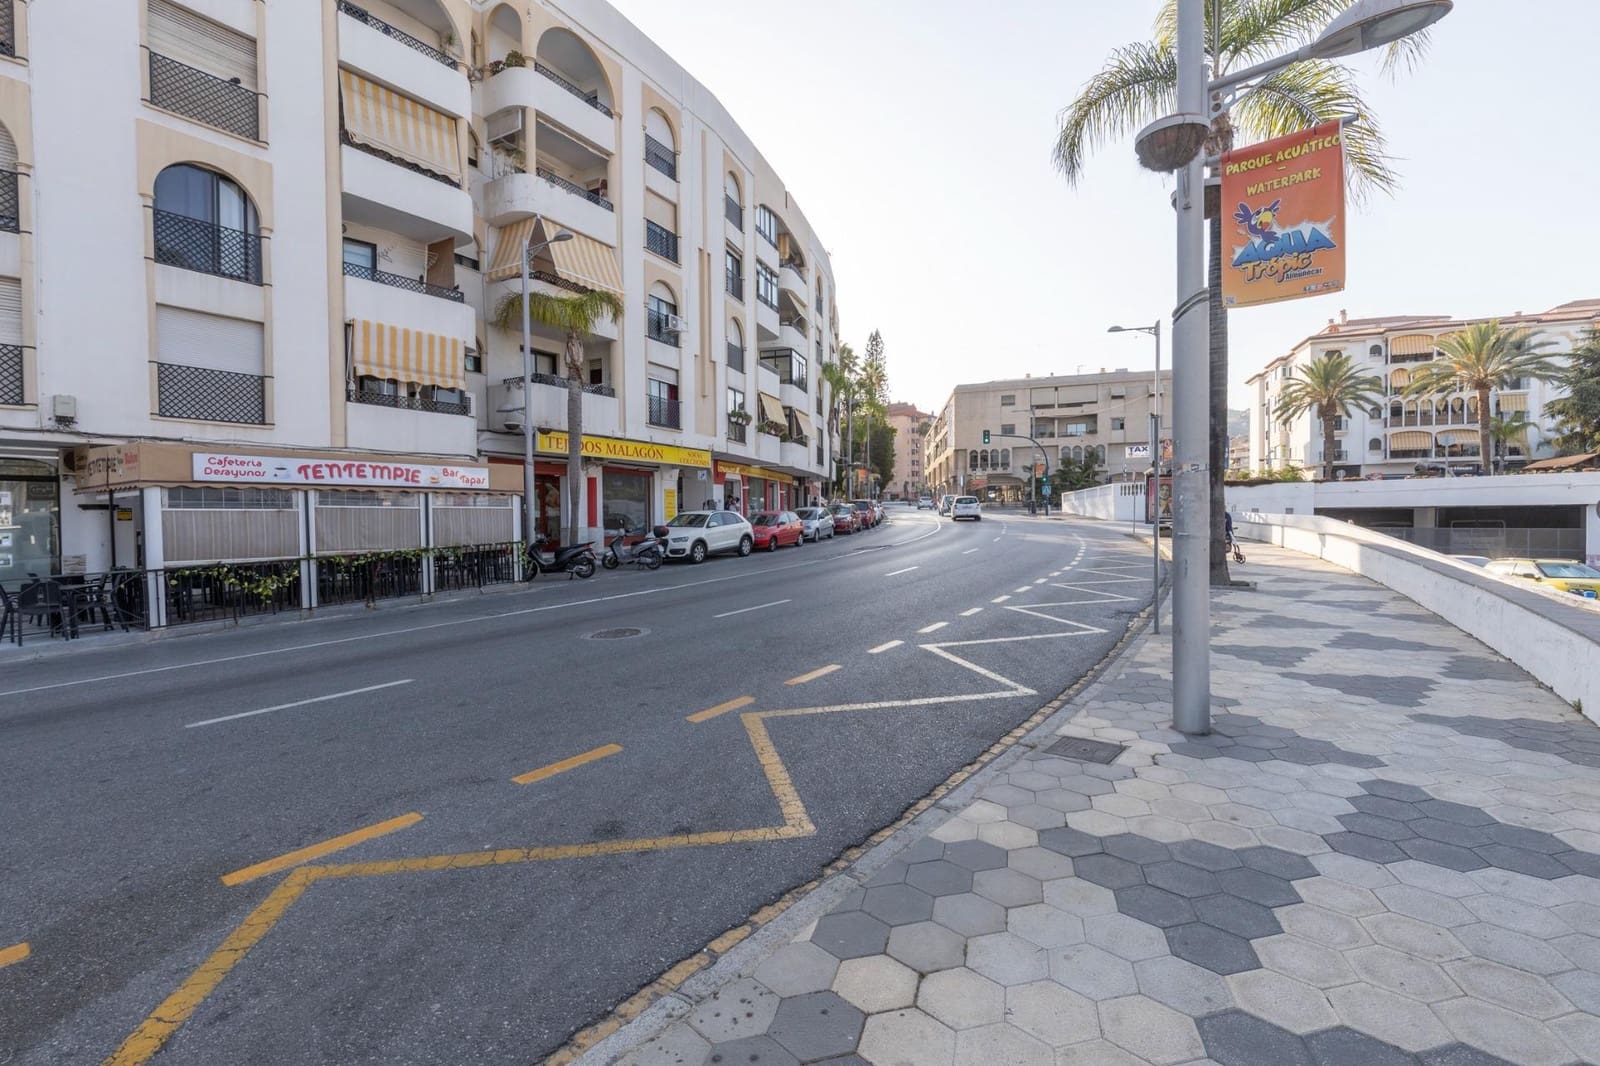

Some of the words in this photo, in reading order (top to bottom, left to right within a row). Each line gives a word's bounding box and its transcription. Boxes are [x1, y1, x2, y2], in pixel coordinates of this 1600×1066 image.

[1226, 154, 1272, 176] PARQUE
[1247, 167, 1322, 197] WATERPARK
[606, 443, 664, 460] MALAGÓN
[203, 467, 266, 479] Desayunos
[297, 462, 421, 484] TENTEMPIE
[442, 467, 459, 478] Bar
[460, 474, 486, 487] Tapas
